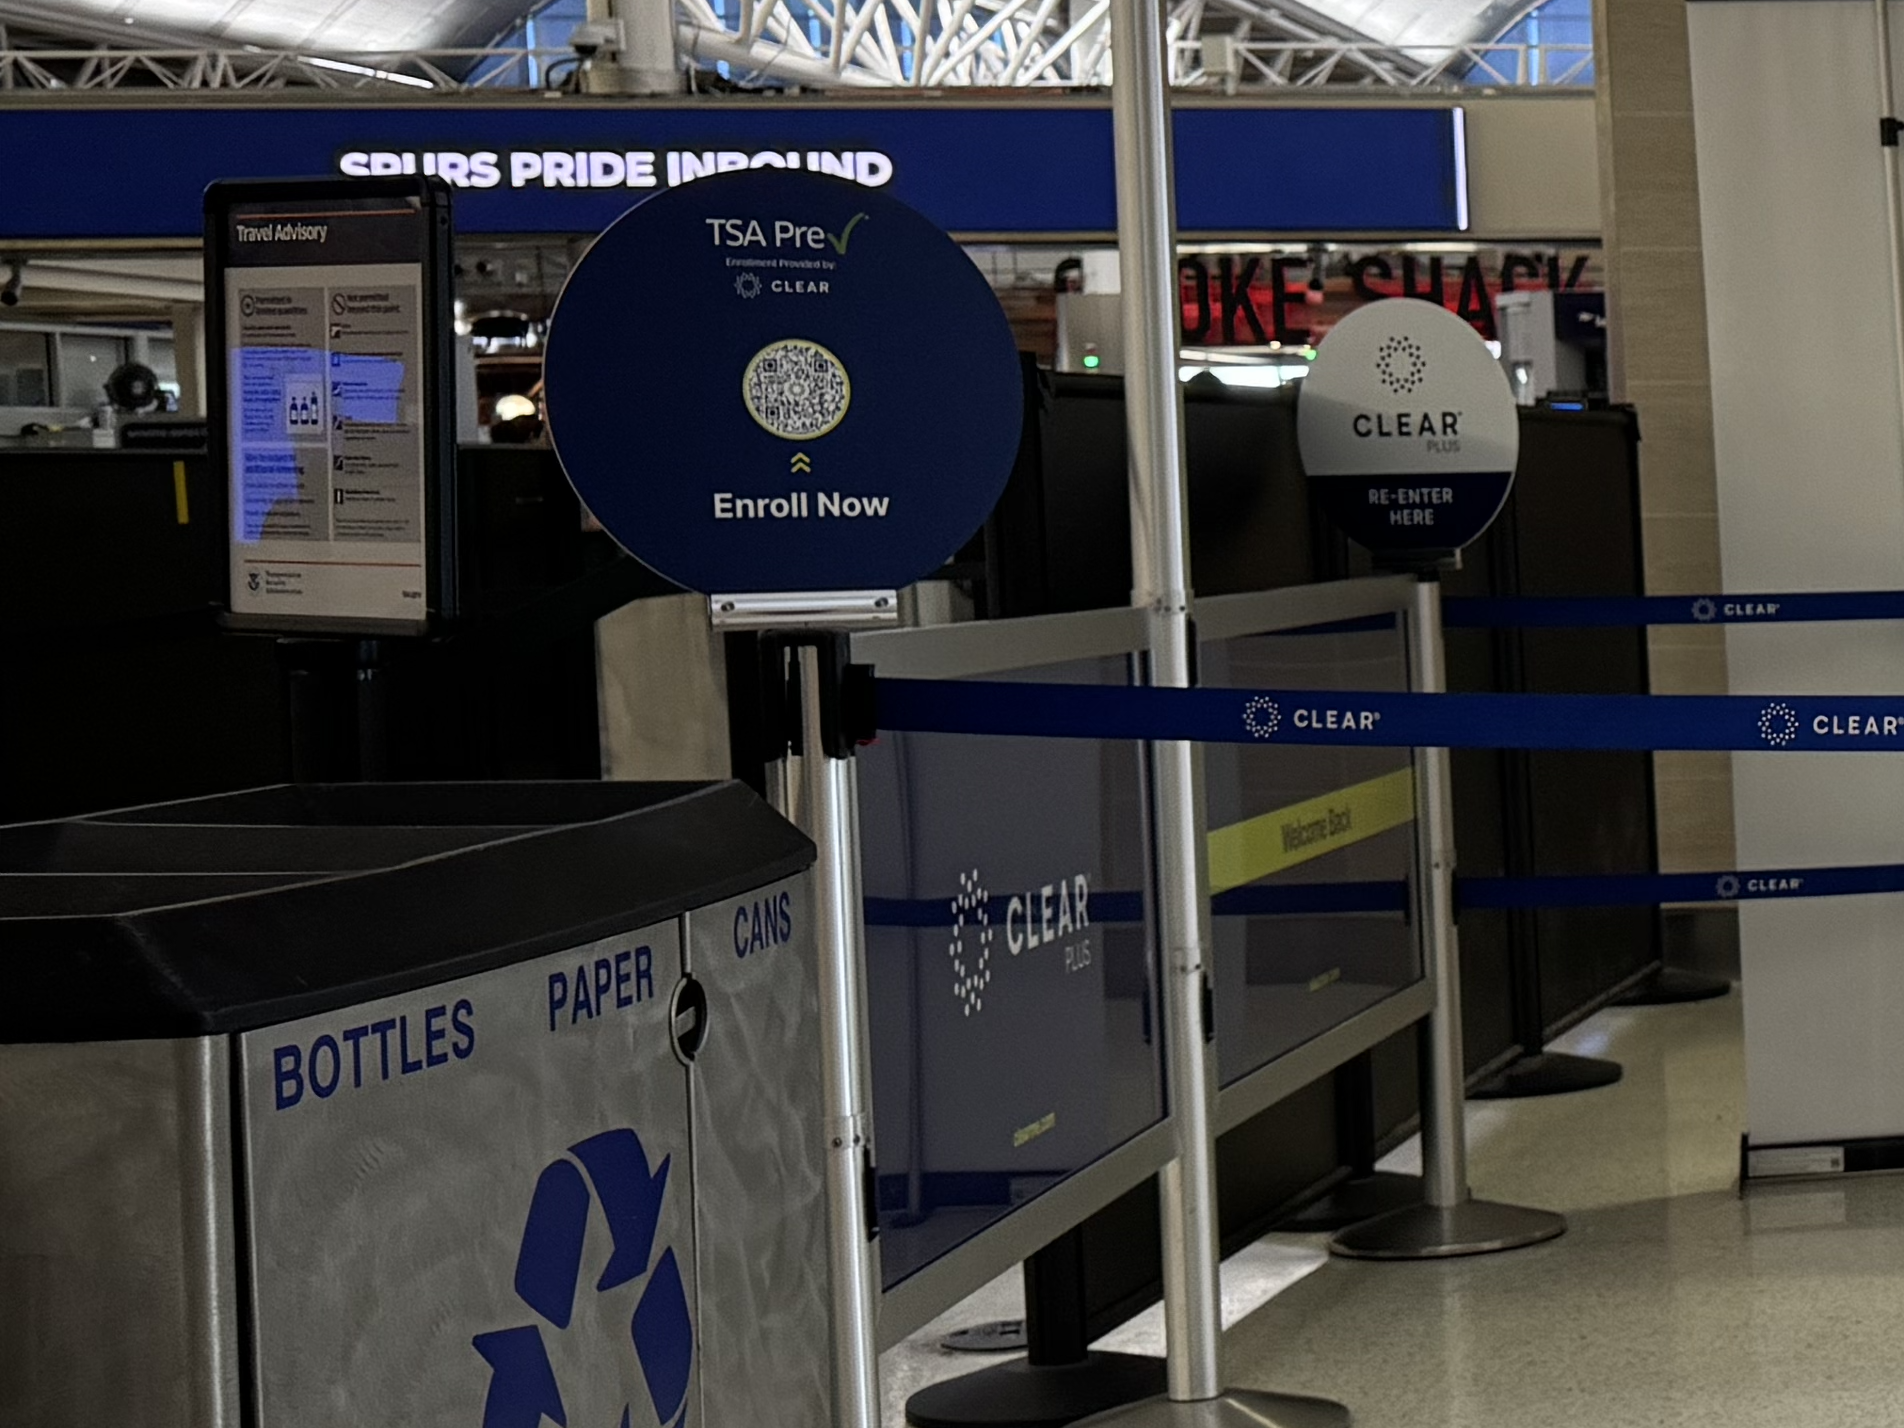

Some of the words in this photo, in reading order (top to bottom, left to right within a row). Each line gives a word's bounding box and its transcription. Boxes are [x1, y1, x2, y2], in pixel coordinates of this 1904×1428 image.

[510, 151, 658, 188] PRIDE
[237, 224, 273, 242] Travel
[274, 222, 328, 243] Advisory
[705, 218, 767, 247] TSA
[771, 279, 830, 293] CLEAR
[1353, 412, 1459, 439] CLEAR
[1426, 439, 1461, 454] PLUS
[713, 492, 808, 519] Enroll
[817, 492, 890, 518] Now
[1368, 487, 1454, 506] RE-ENTER
[1389, 509, 1434, 527] HERE
[1723, 602, 1776, 617] CLEAR
[1280, 817, 1327, 854] Welcome
[733, 891, 792, 959] CANS
[1007, 873, 1091, 956] CLEAR
[1065, 939, 1092, 973] PLUS
[548, 945, 655, 1032] PAPER
[273, 999, 475, 1112] BOTTLES
